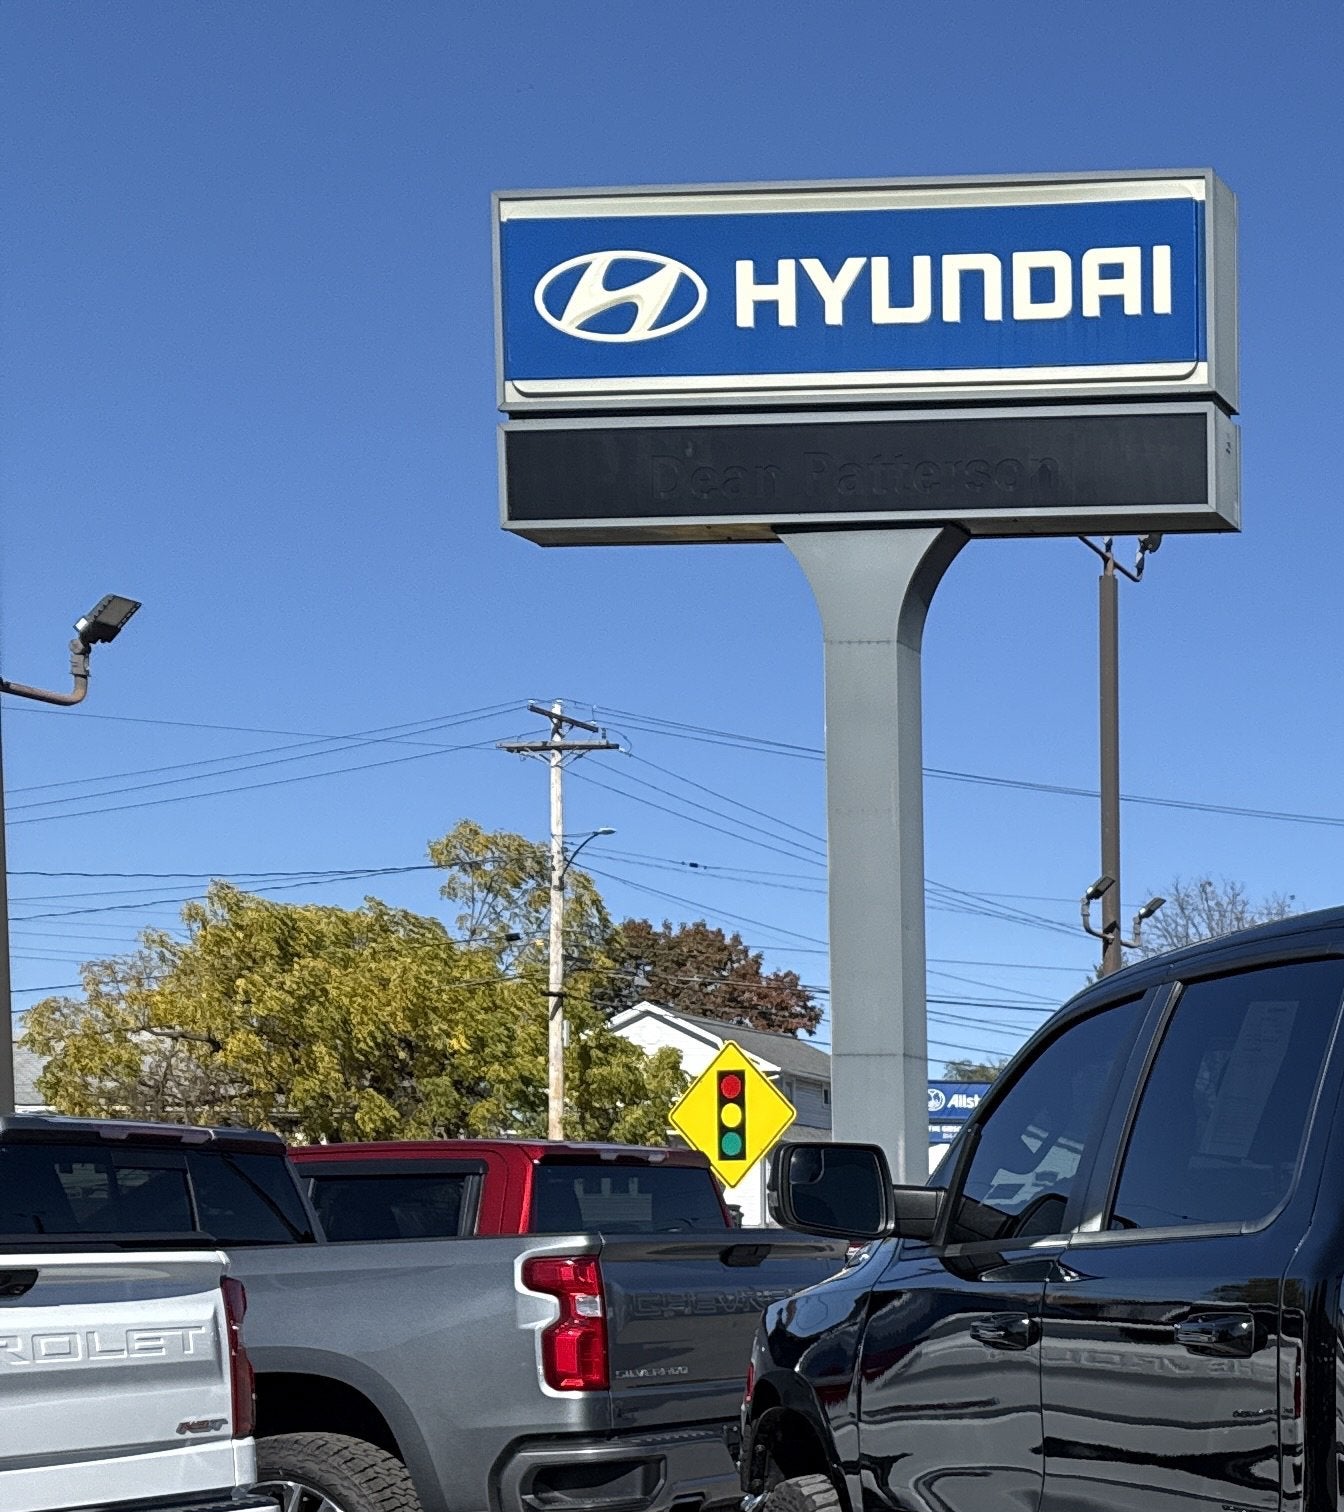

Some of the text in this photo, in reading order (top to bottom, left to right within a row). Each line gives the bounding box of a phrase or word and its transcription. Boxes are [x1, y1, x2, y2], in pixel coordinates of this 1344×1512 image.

[735, 244, 1173, 329] HYUNDAI
[651, 450, 1063, 500] Dean Patterson
